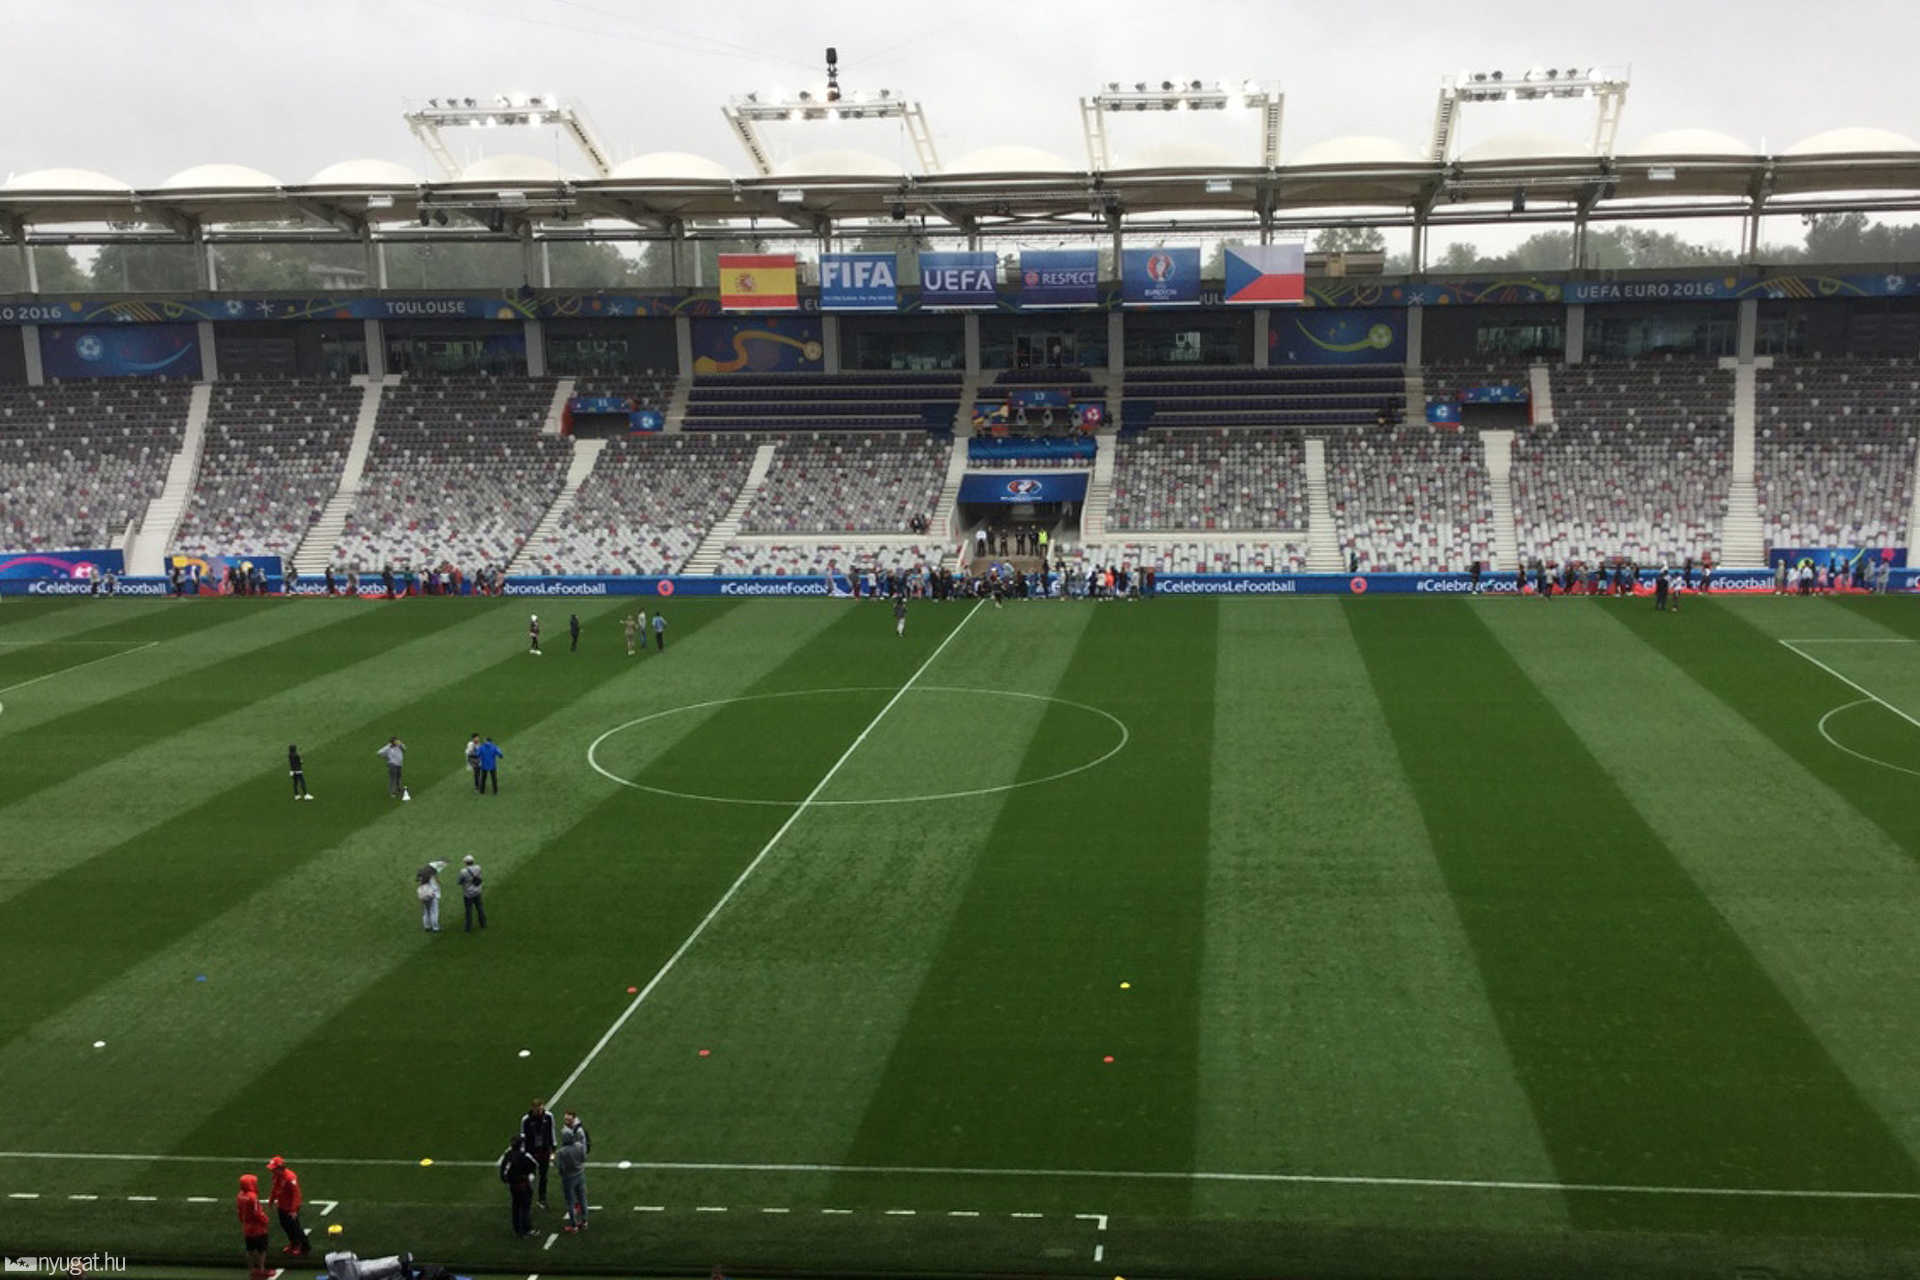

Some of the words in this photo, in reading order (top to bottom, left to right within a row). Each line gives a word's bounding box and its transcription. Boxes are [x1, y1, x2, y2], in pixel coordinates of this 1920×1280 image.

[822, 261, 895, 288] FIFA
[924, 270, 993, 291] UEFA
[1042, 272, 1096, 285] RESPECT
[1577, 285, 1621, 298] UEFA
[1624, 284, 1669, 297] EURO
[1673, 283, 1715, 296] 2016
[19, 307, 61, 319] 2016
[385, 301, 465, 314] TOULOUSE
[1155, 580, 1296, 592] #CelebronsLeFootball
